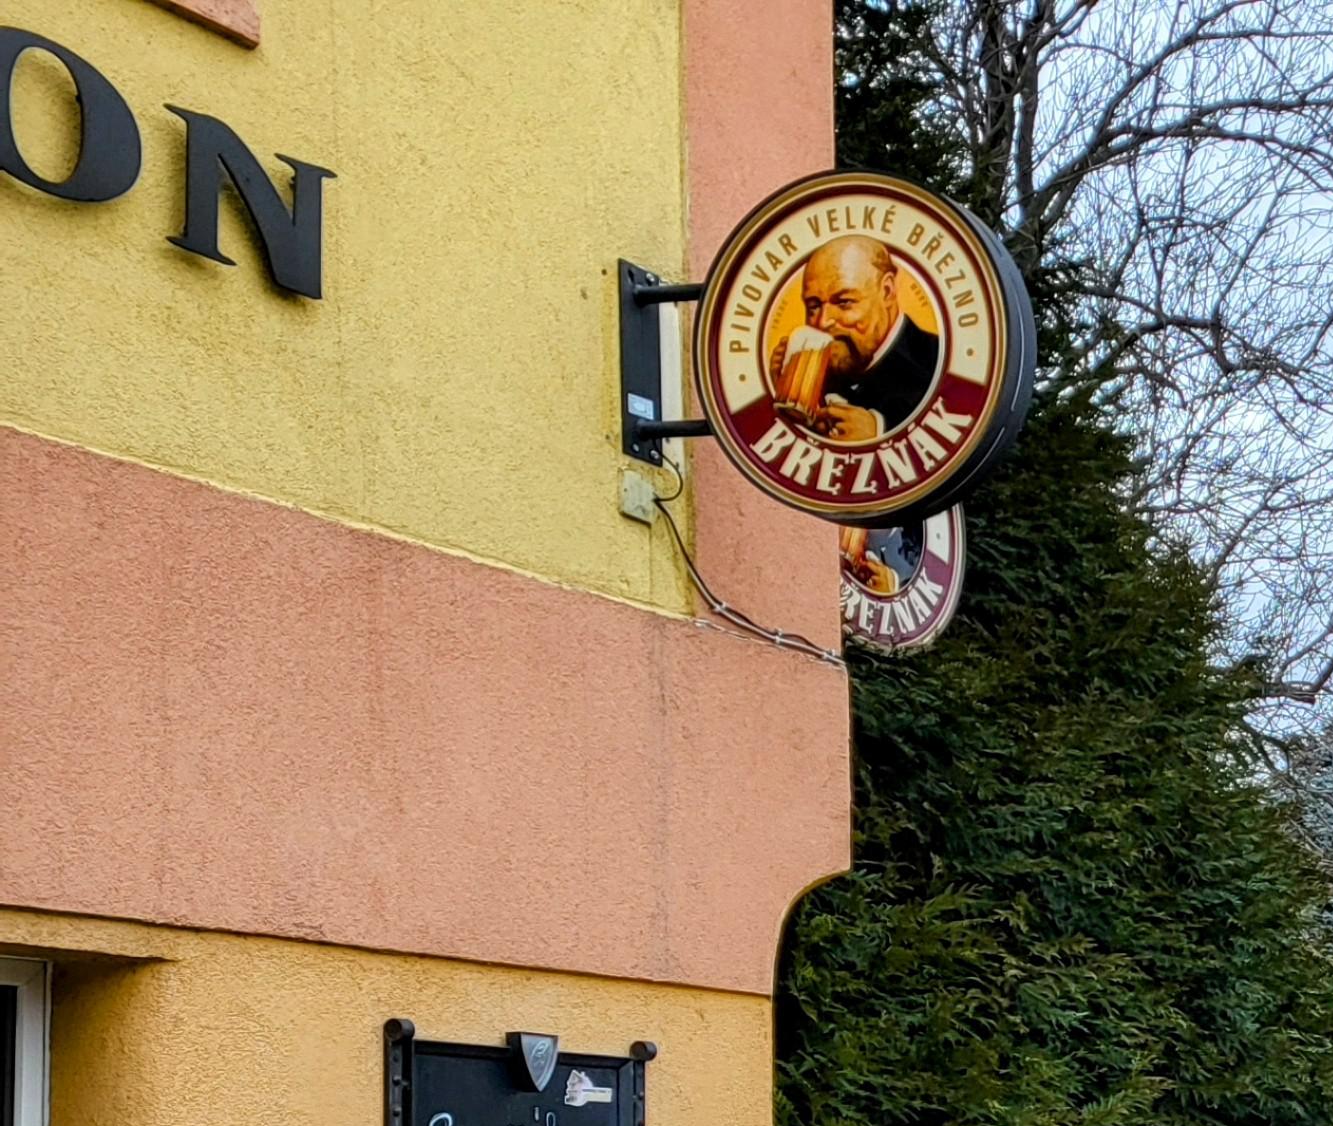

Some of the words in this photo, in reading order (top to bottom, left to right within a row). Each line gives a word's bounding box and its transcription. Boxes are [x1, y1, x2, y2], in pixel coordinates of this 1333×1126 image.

[729, 233, 798, 354] PIVOVAR
[806, 205, 897, 238] VELKÉ
[907, 223, 979, 328] BŘEZNO
[749, 396, 974, 495] BŘEZŇÁK
